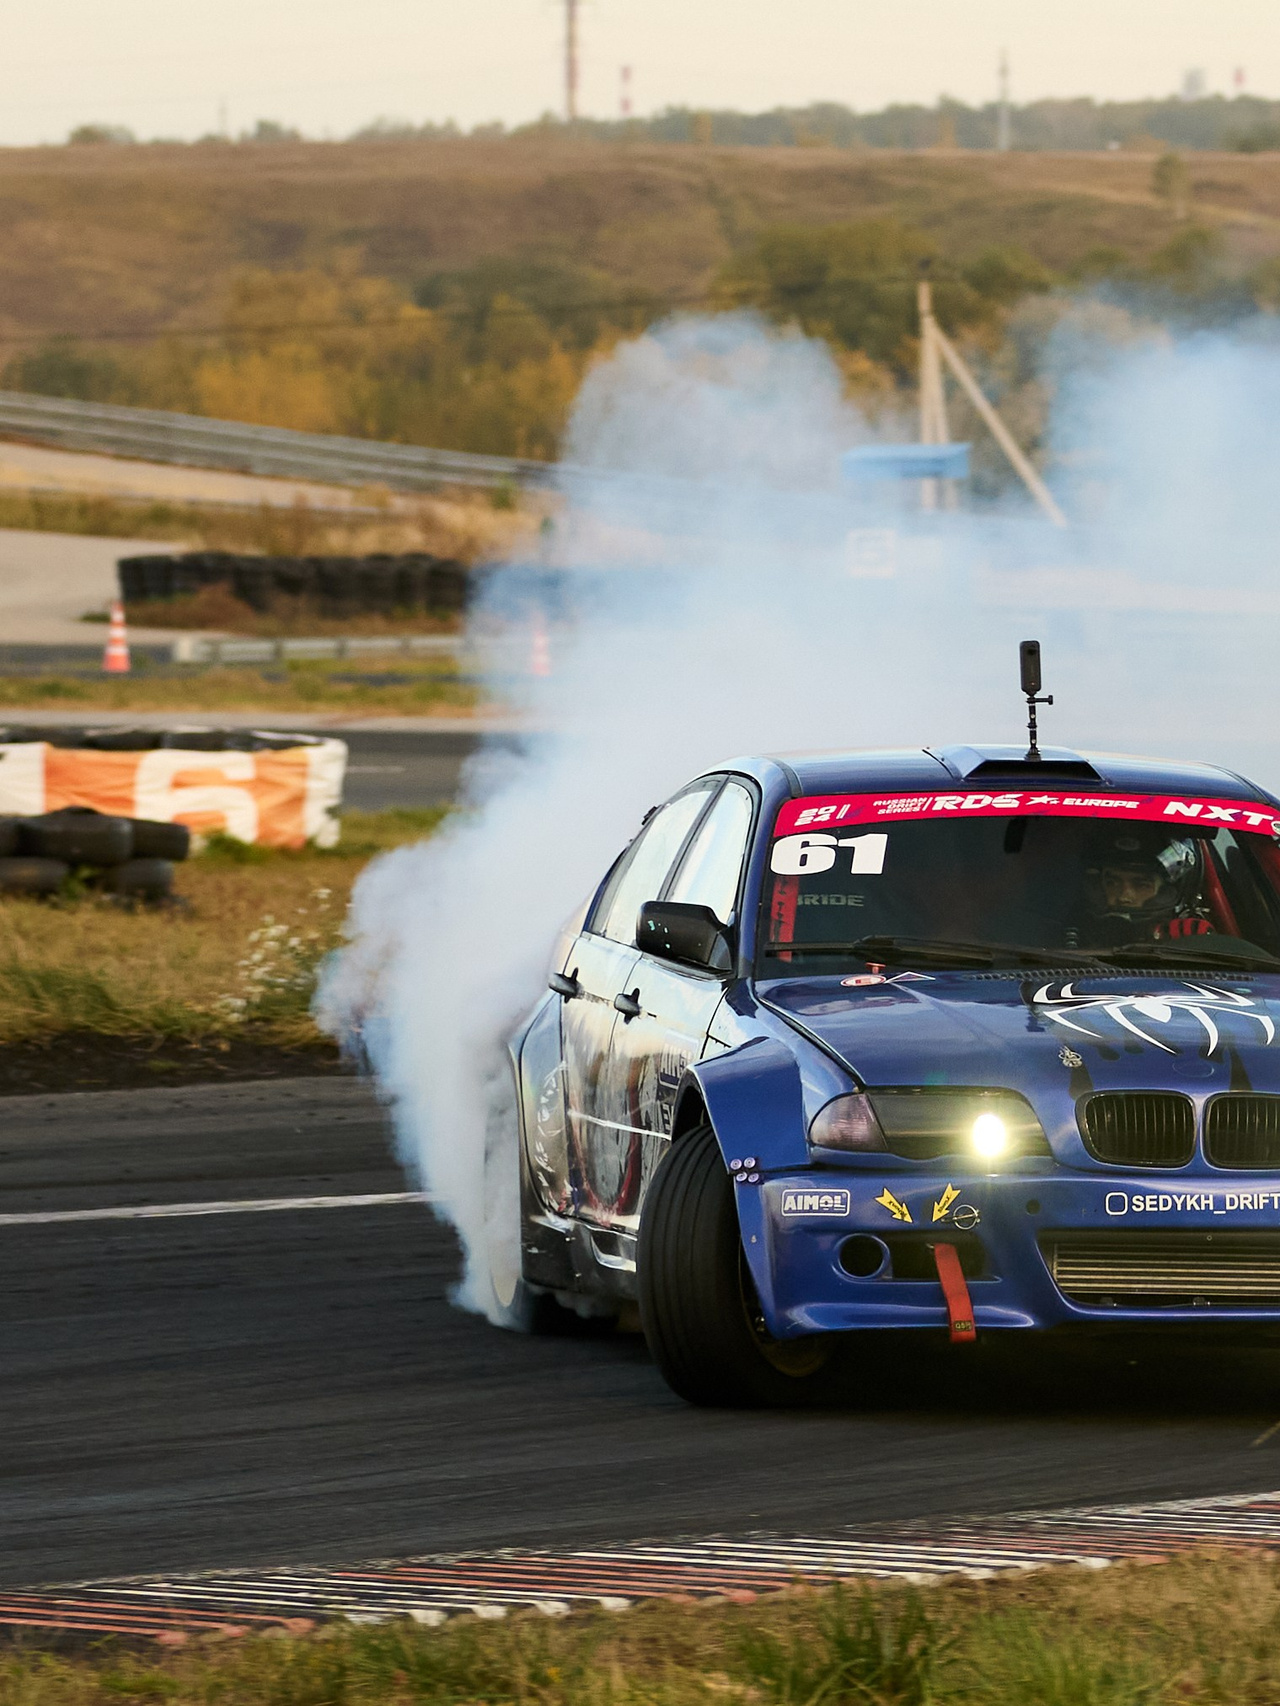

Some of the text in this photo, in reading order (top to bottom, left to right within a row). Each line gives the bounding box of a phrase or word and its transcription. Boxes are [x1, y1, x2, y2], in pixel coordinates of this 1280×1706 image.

[932, 793, 1274, 826] RDS EUROPE NXT
[770, 833, 888, 875] 61
[784, 1195, 846, 1211] AIMOL
